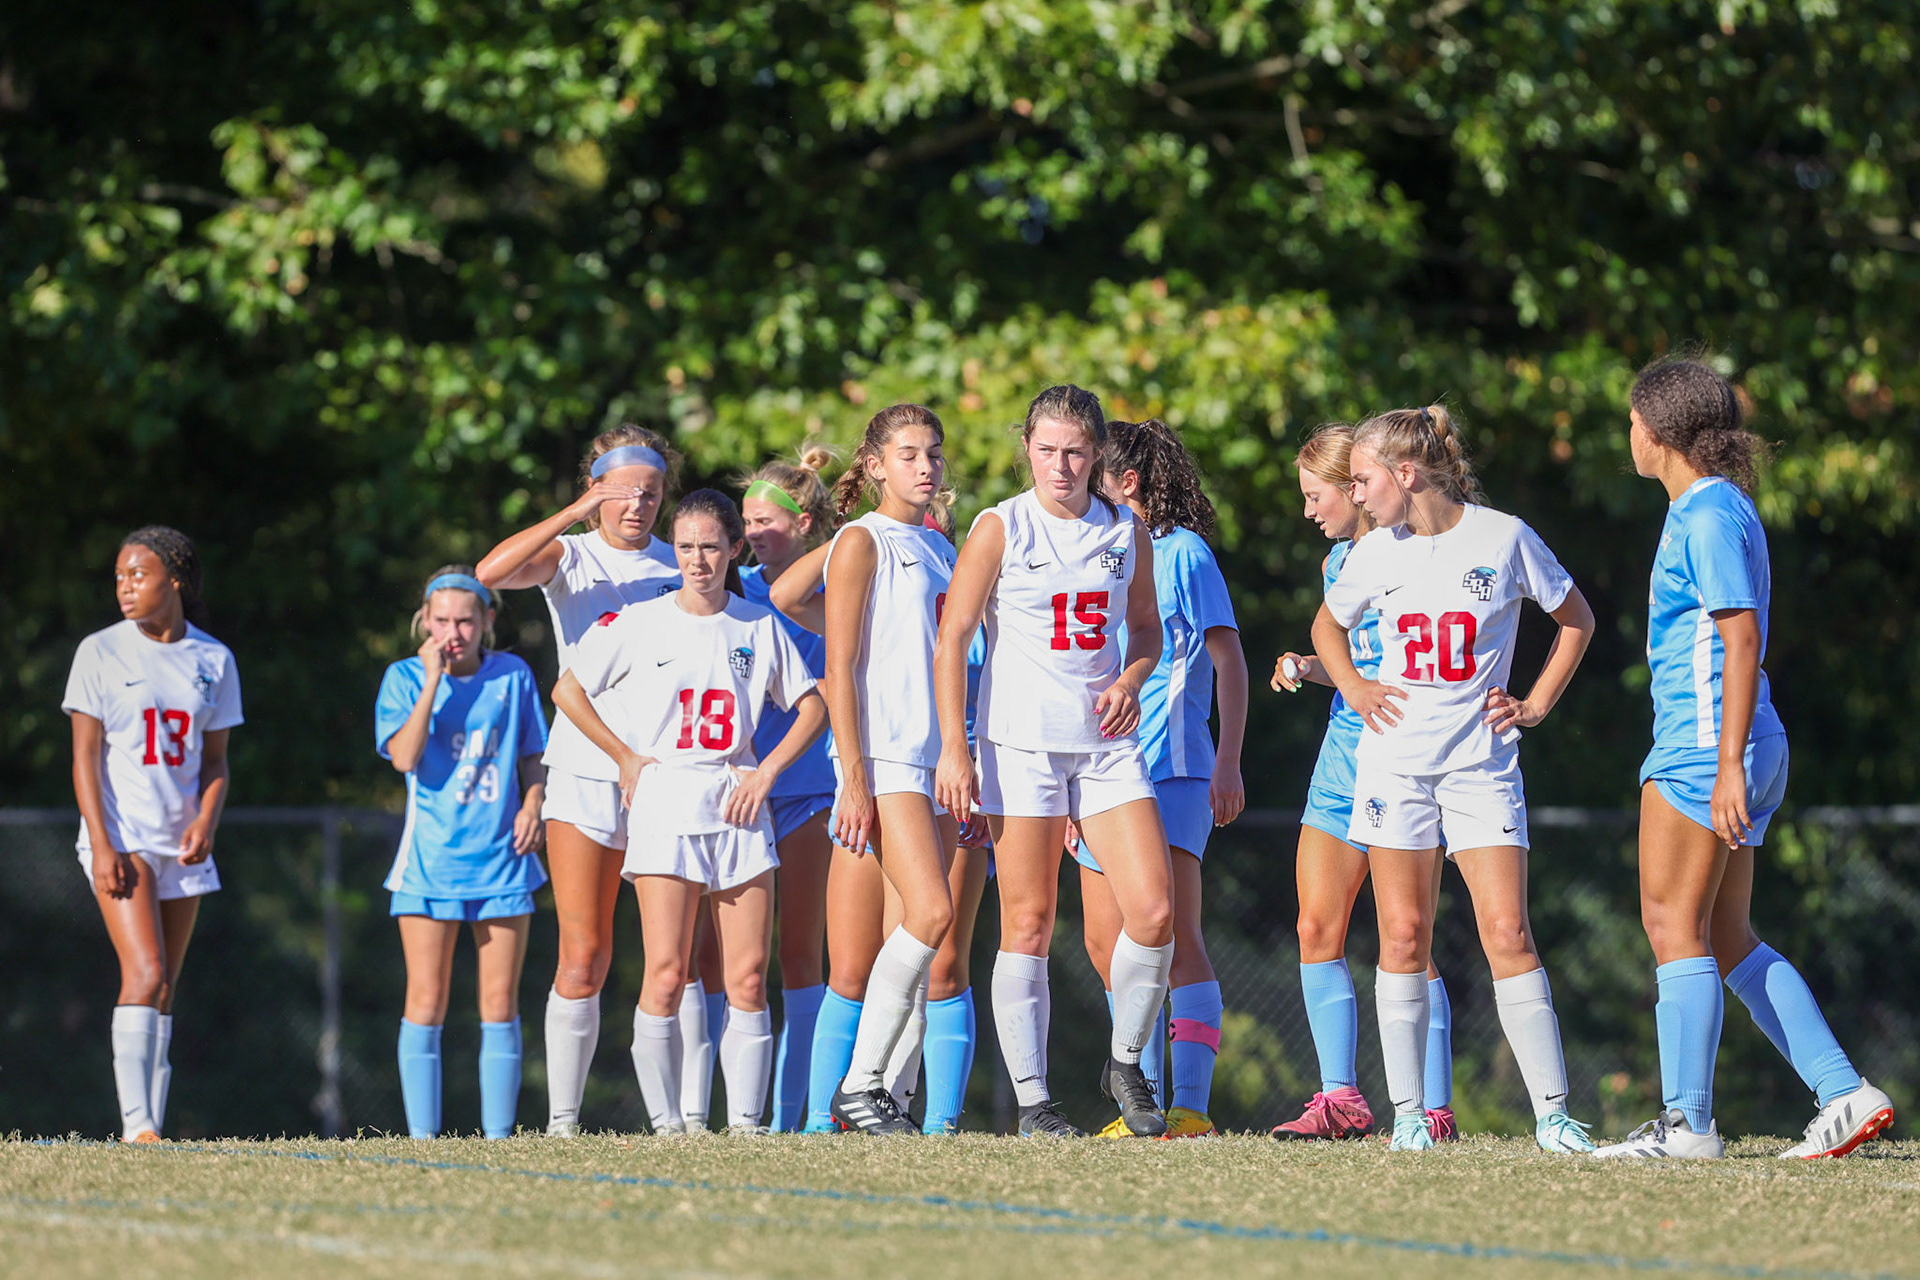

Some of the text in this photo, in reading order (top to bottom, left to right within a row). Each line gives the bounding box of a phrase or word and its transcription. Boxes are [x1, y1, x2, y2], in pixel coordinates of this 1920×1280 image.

[1101, 553, 1123, 579] SBA
[1463, 572, 1493, 601] SBA
[1051, 591, 1109, 650] 15
[729, 650, 752, 678] SBA
[1397, 611, 1477, 682] 20
[143, 707, 190, 767] 13
[676, 688, 735, 751] 18
[451, 728, 499, 761] SAA
[455, 763, 499, 805] 39
